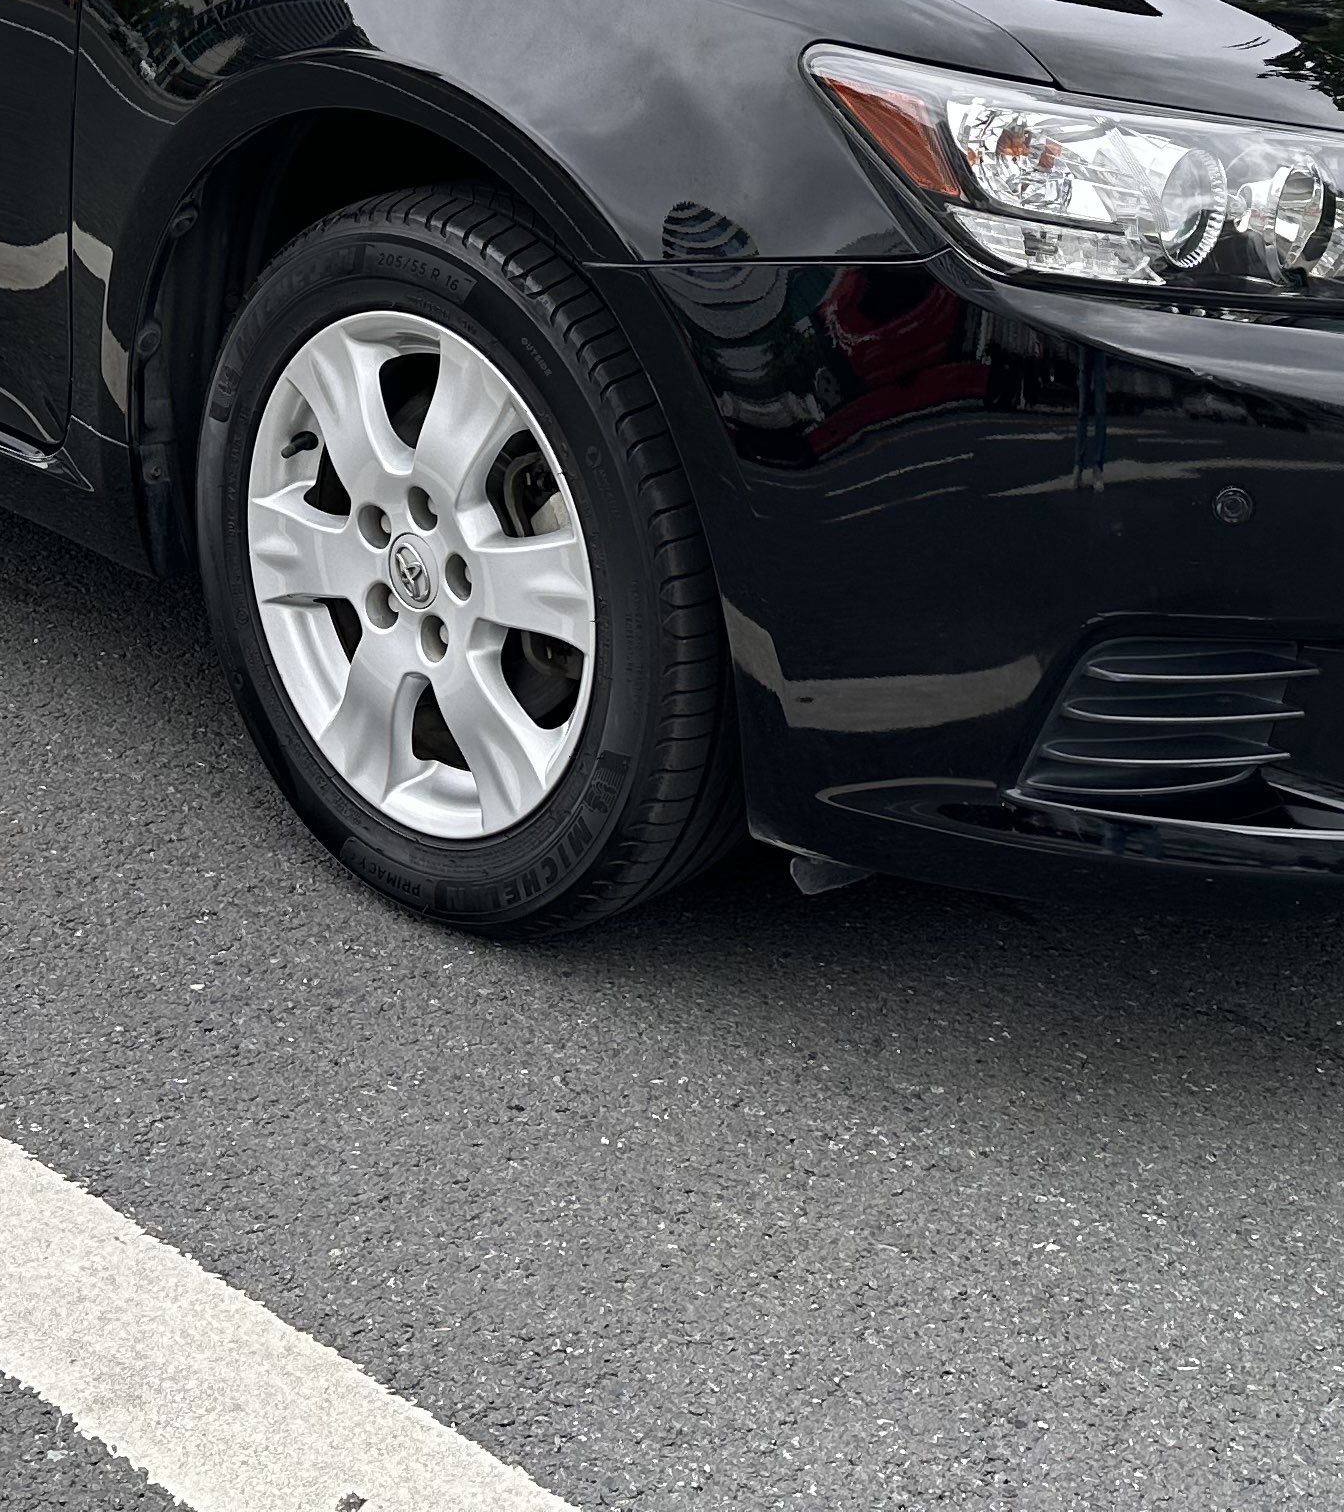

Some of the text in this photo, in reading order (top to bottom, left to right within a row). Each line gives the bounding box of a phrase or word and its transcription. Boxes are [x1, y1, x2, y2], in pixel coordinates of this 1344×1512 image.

[378, 252, 460, 291] 205/55 R 16
[521, 337, 553, 377] OUTSIDE
[358, 857, 421, 898] PRIMACY
